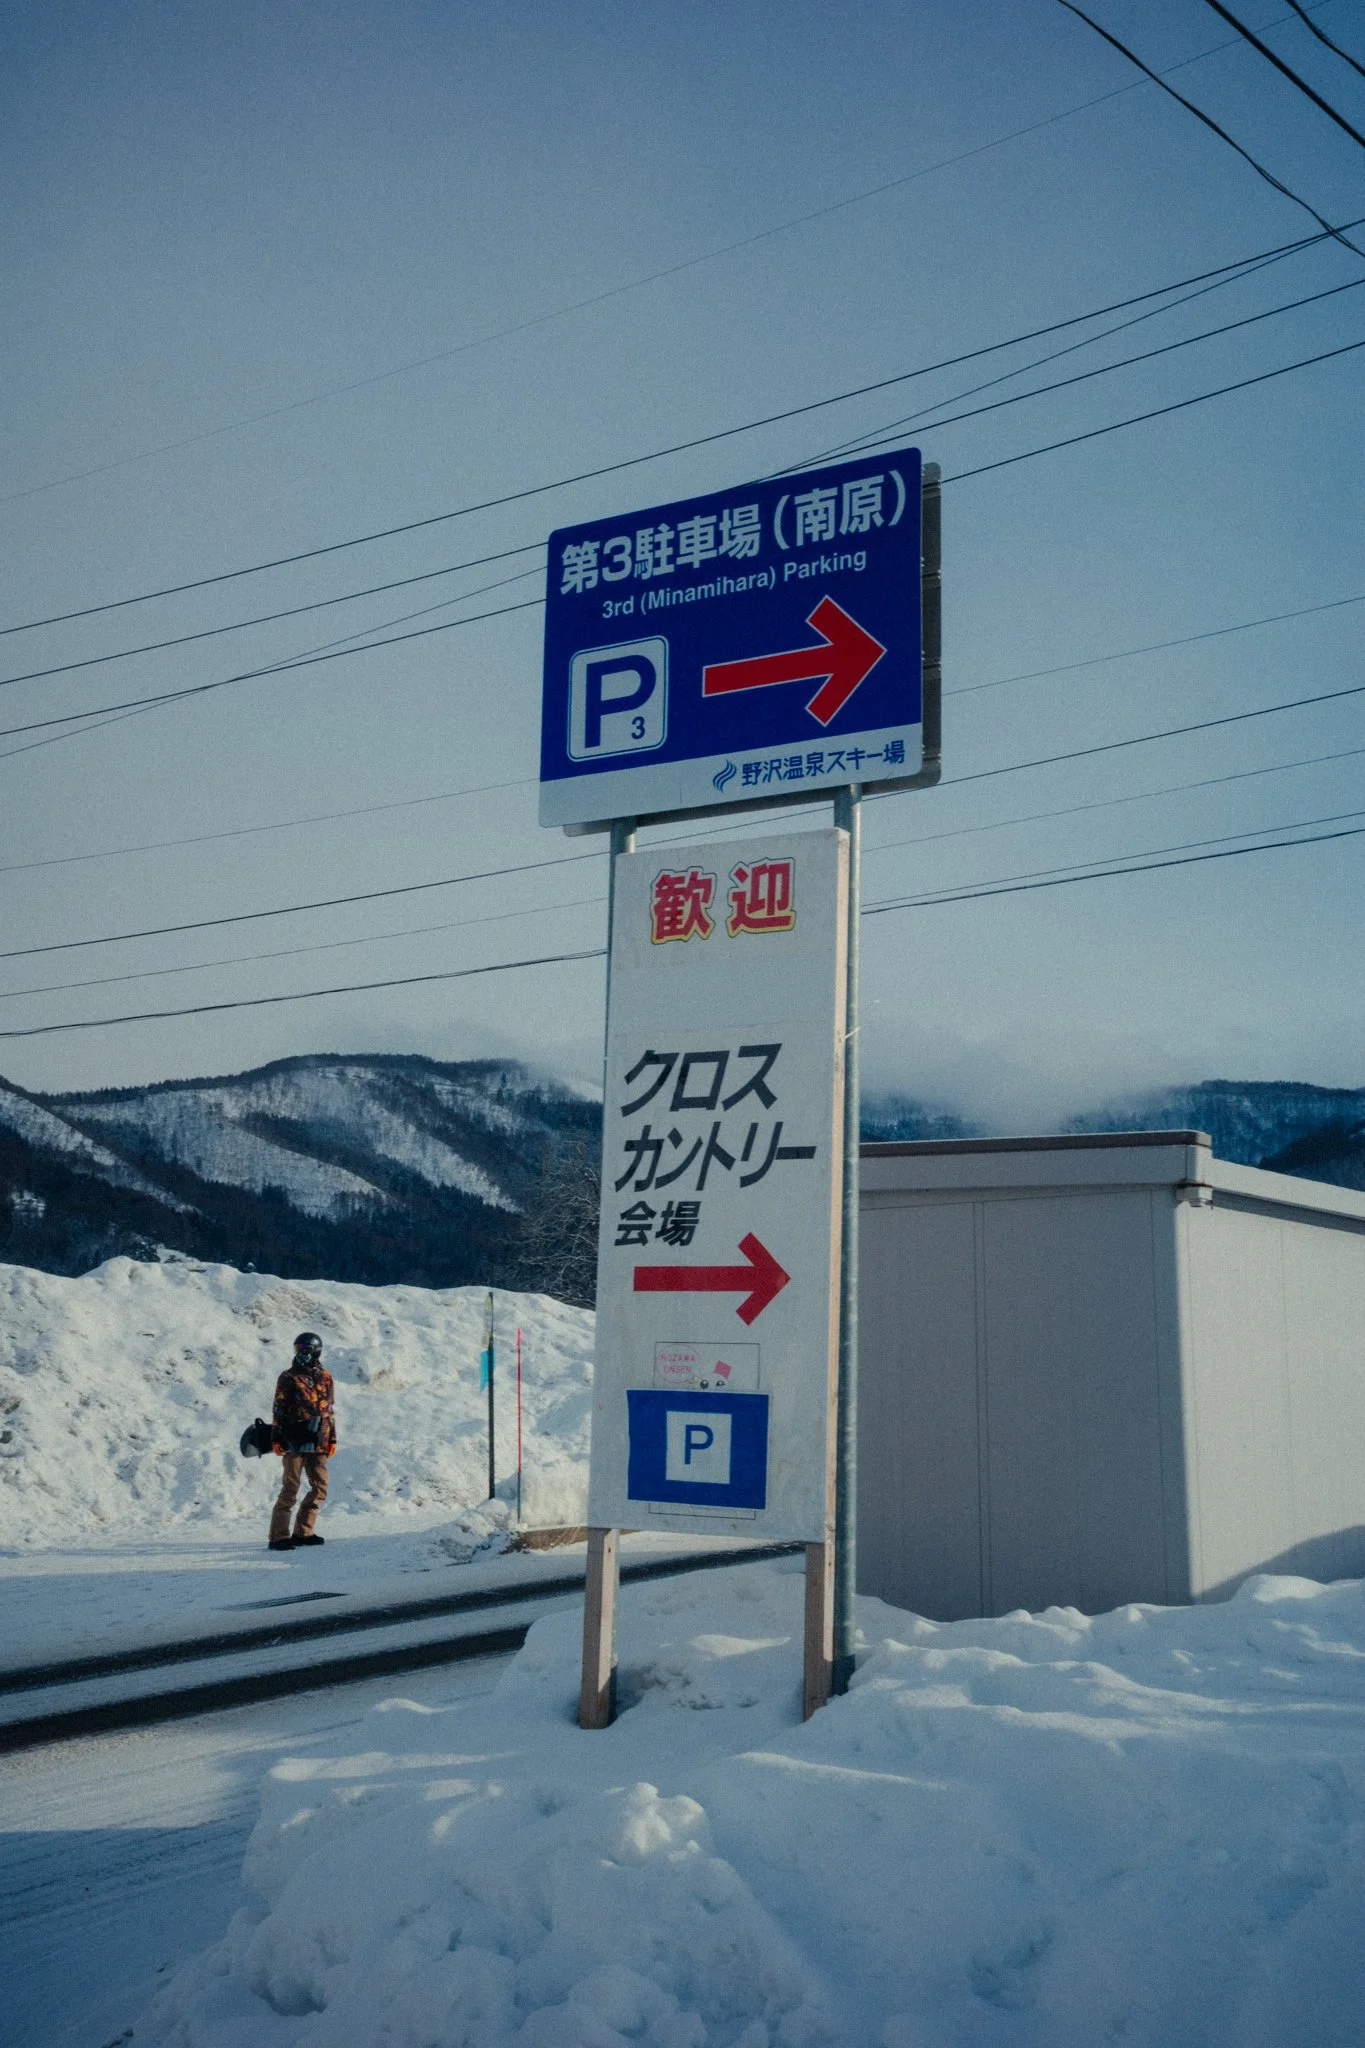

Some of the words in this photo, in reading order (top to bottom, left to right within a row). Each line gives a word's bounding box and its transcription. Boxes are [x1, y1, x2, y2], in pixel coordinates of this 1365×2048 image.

[602, 596, 634, 619] 3rd
[640, 566, 776, 615] (Minamihara)
[783, 550, 867, 582] Parking
[584, 653, 657, 750] P
[630, 716, 646, 740] 3
[741, 739, 906, 787] 野沢温泉スキー場
[652, 860, 795, 943] 歓迎
[620, 1043, 783, 1117] クロス
[615, 1121, 817, 1193] カントリー
[614, 1200, 701, 1247] 会場
[684, 1424, 714, 1465] P
